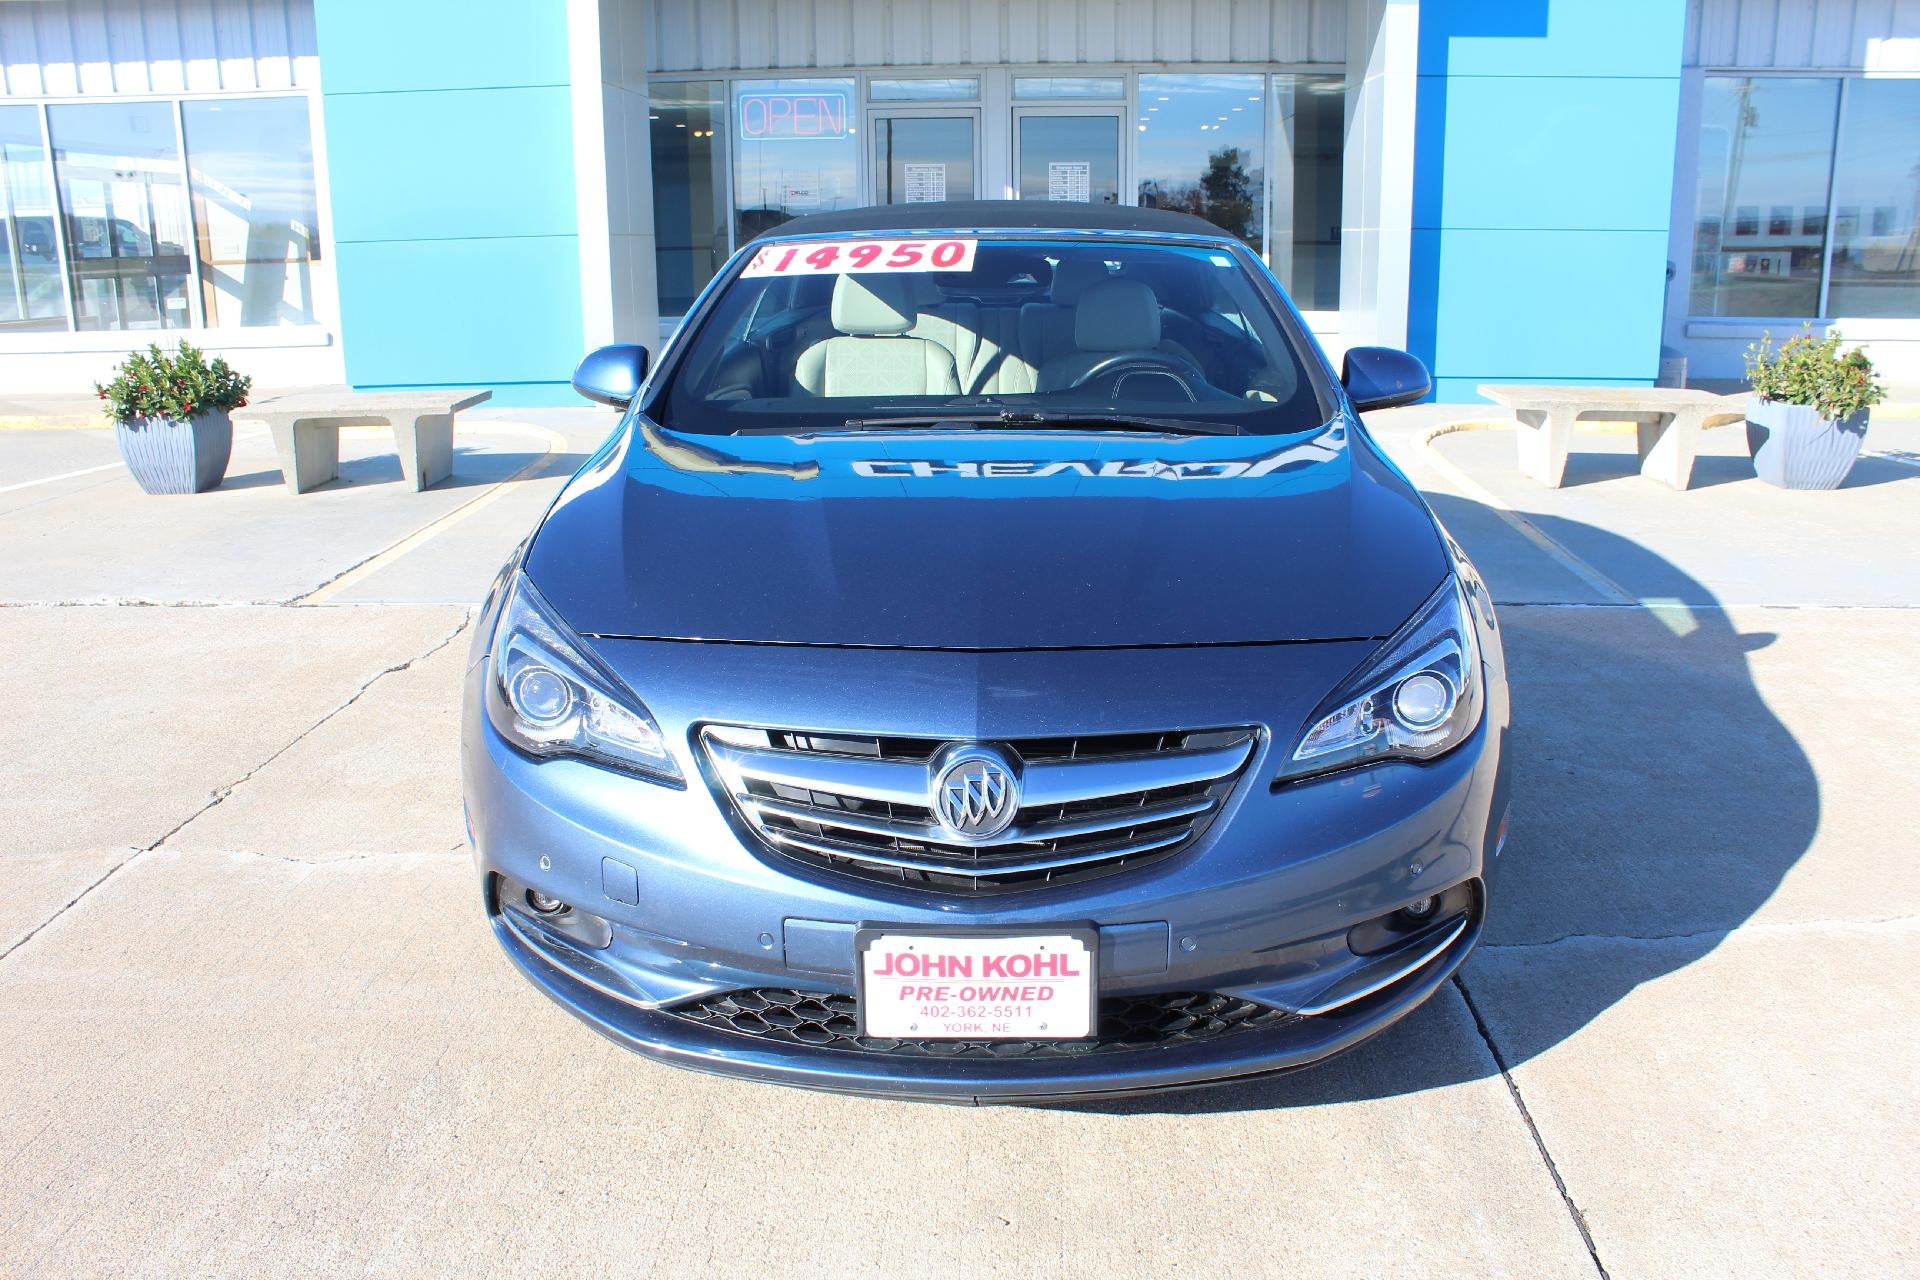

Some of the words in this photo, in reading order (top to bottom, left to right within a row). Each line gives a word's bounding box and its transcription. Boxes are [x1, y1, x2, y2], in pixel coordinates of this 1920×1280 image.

[744, 97, 842, 135] OPEN
[874, 953, 972, 978] JOHN
[983, 953, 1080, 978] KOHL
[899, 986, 1054, 1002] PRE-OWNED
[920, 1005, 1032, 1018] 402-362-5511
[992, 1023, 1011, 1033] NE
